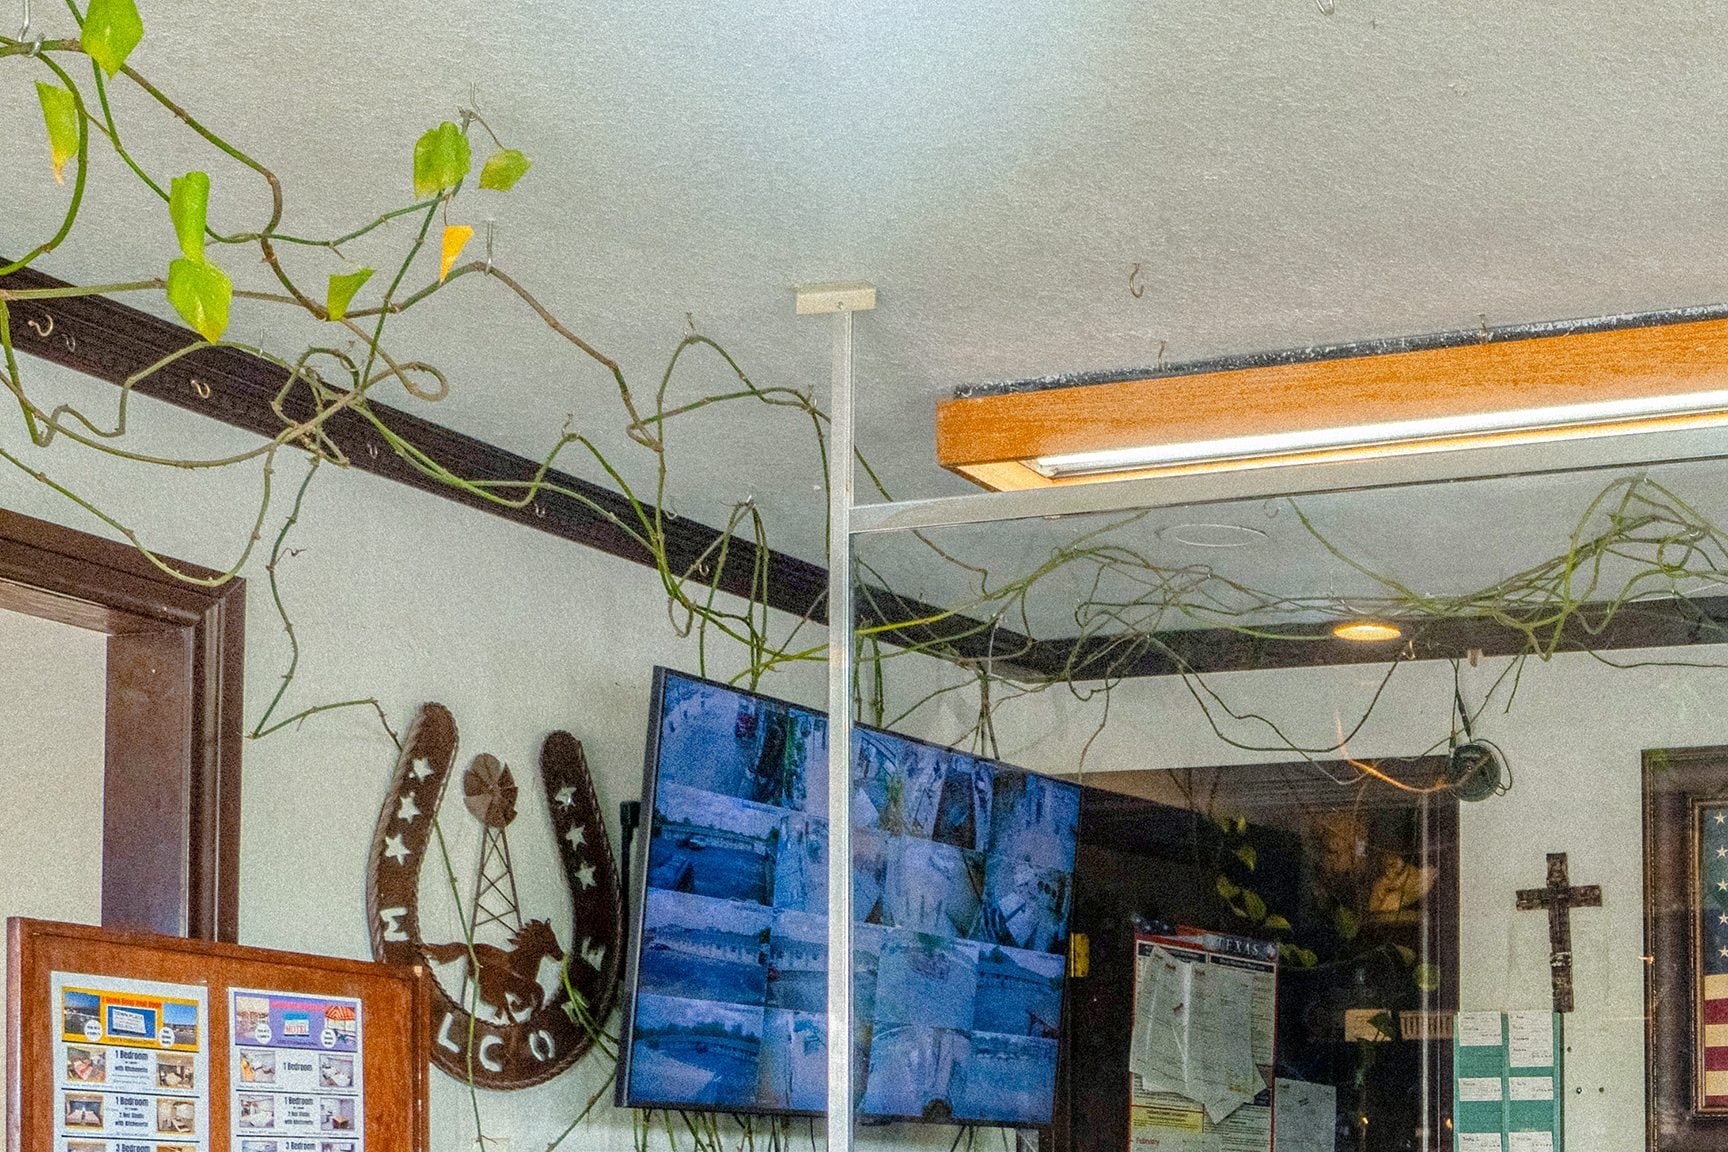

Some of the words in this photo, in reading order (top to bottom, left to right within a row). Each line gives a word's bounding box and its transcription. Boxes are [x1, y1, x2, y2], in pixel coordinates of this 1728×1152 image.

[1217, 938, 1259, 955] TEXAS
[285, 1025, 308, 1033] MOTEL
[120, 1050, 148, 1060] Bedroom
[287, 1062, 312, 1071] Bedroom
[120, 1097, 149, 1107] Bedroom
[288, 1097, 314, 1105] Bedroom
[121, 1144, 151, 1152] Bedroom
[290, 1142, 316, 1150] Bedroom
